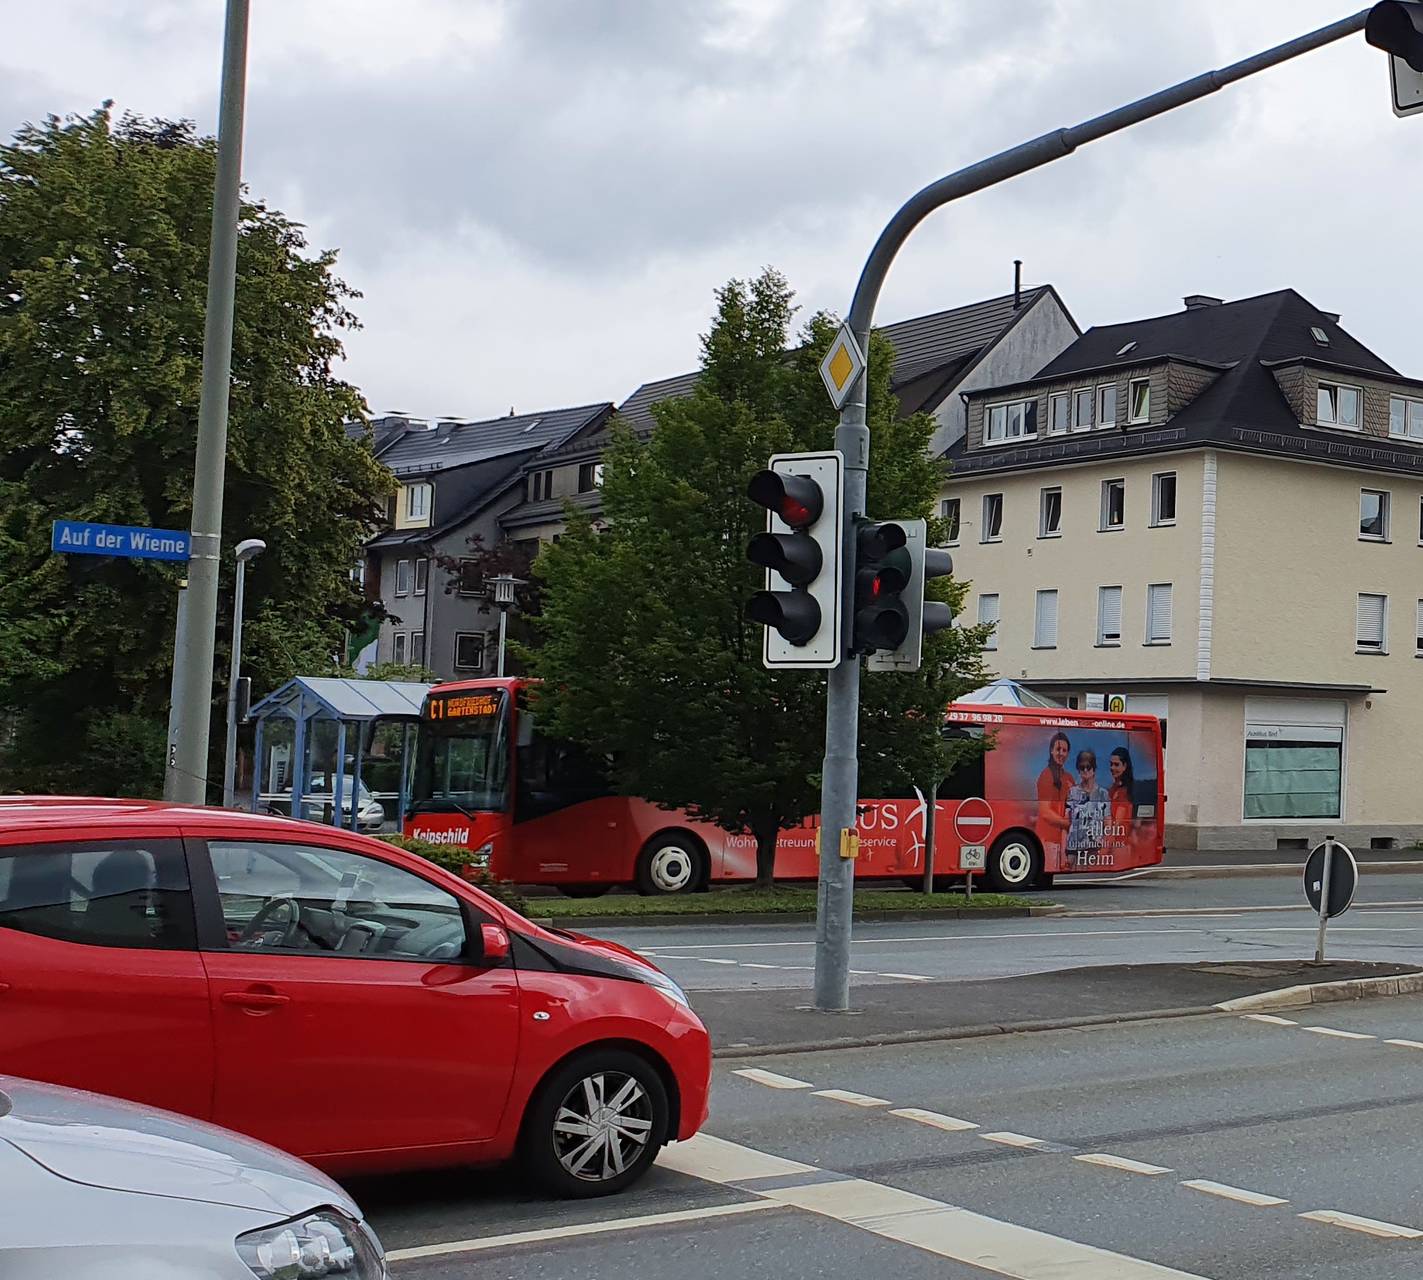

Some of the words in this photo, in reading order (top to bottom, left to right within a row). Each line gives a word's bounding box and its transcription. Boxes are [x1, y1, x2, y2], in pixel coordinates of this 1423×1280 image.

[60, 526, 91, 546] Auf
[96, 530, 124, 548] der
[130, 532, 185, 553] Wieme
[431, 699, 444, 720] C1
[447, 704, 497, 717] GARTENSTADT
[1086, 820, 1126, 836] allein
[413, 828, 470, 845] Knipschild
[1076, 850, 1114, 866] Heim
